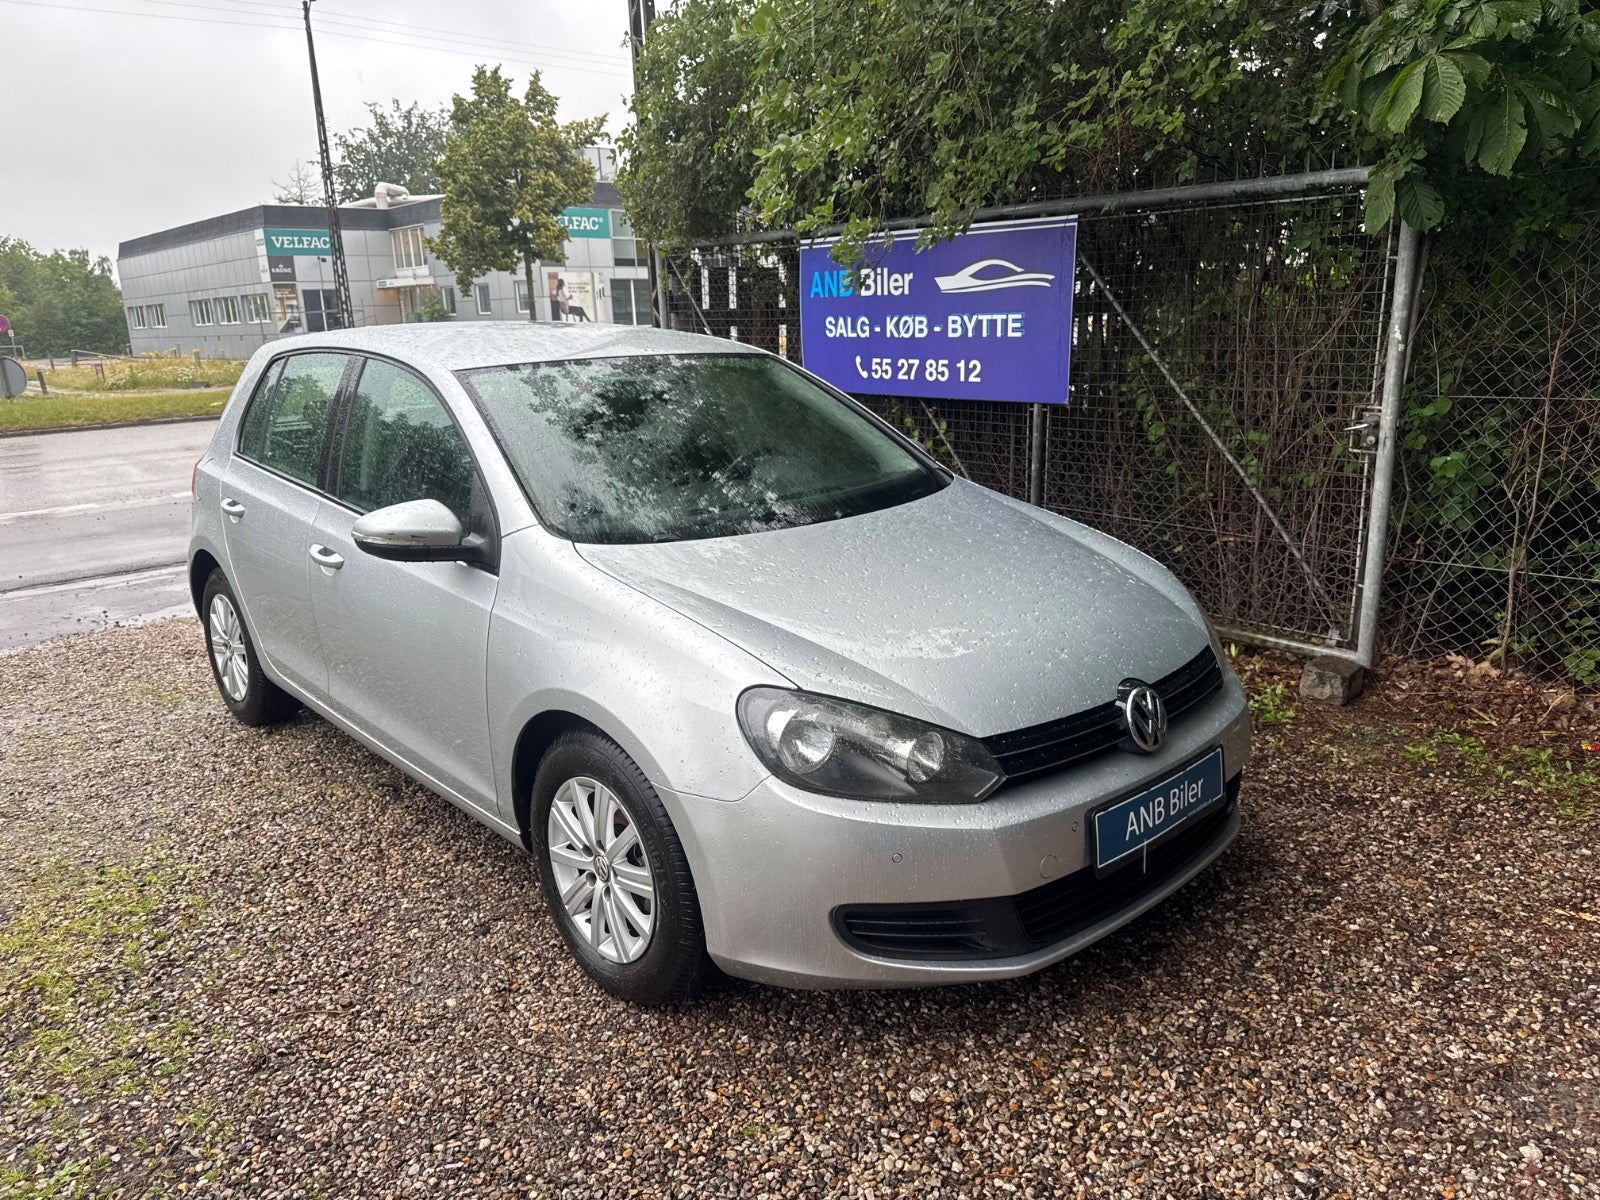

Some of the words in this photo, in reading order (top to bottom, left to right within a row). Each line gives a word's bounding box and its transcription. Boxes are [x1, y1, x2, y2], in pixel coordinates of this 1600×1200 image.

[270, 236, 330, 249] VELFAC
[860, 267, 914, 297] Biler
[825, 316, 869, 338] SALG
[886, 315, 928, 338] KØB
[947, 313, 1024, 338] BYTTE
[871, 358, 892, 380] 55
[897, 359, 920, 380] 27
[925, 359, 949, 381] 85
[956, 360, 981, 383] 12
[1125, 796, 1165, 841] ANB
[1170, 778, 1204, 816] Biler
